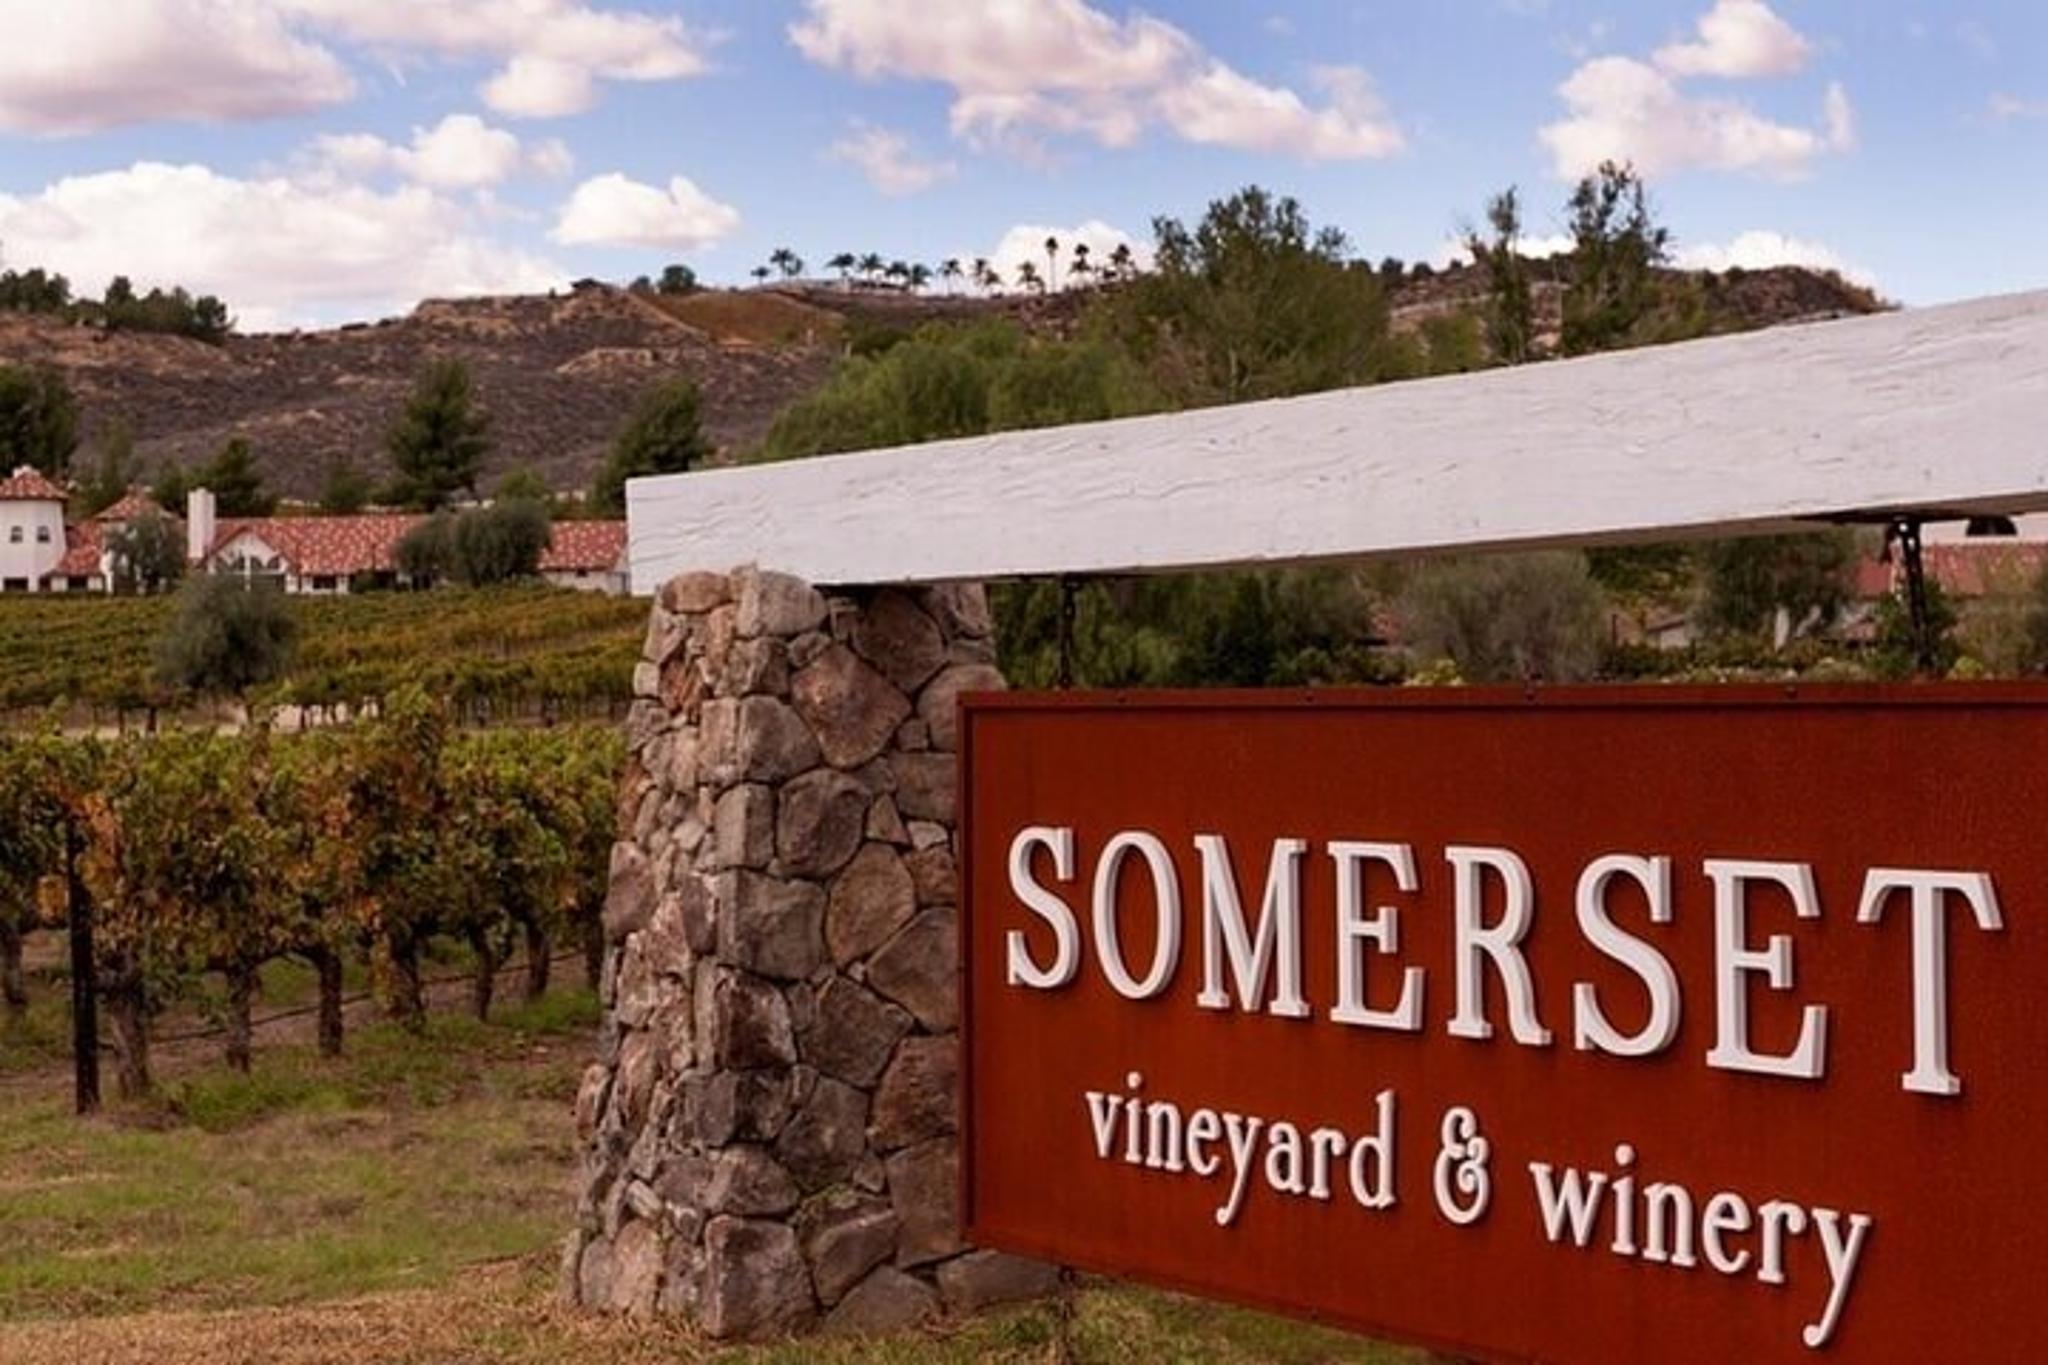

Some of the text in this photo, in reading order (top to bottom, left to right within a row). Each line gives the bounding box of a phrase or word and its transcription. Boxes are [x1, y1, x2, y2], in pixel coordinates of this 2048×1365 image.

[1006, 825, 2003, 1096] SOMERSET
[1086, 1072, 1871, 1348] vineyard & winery
